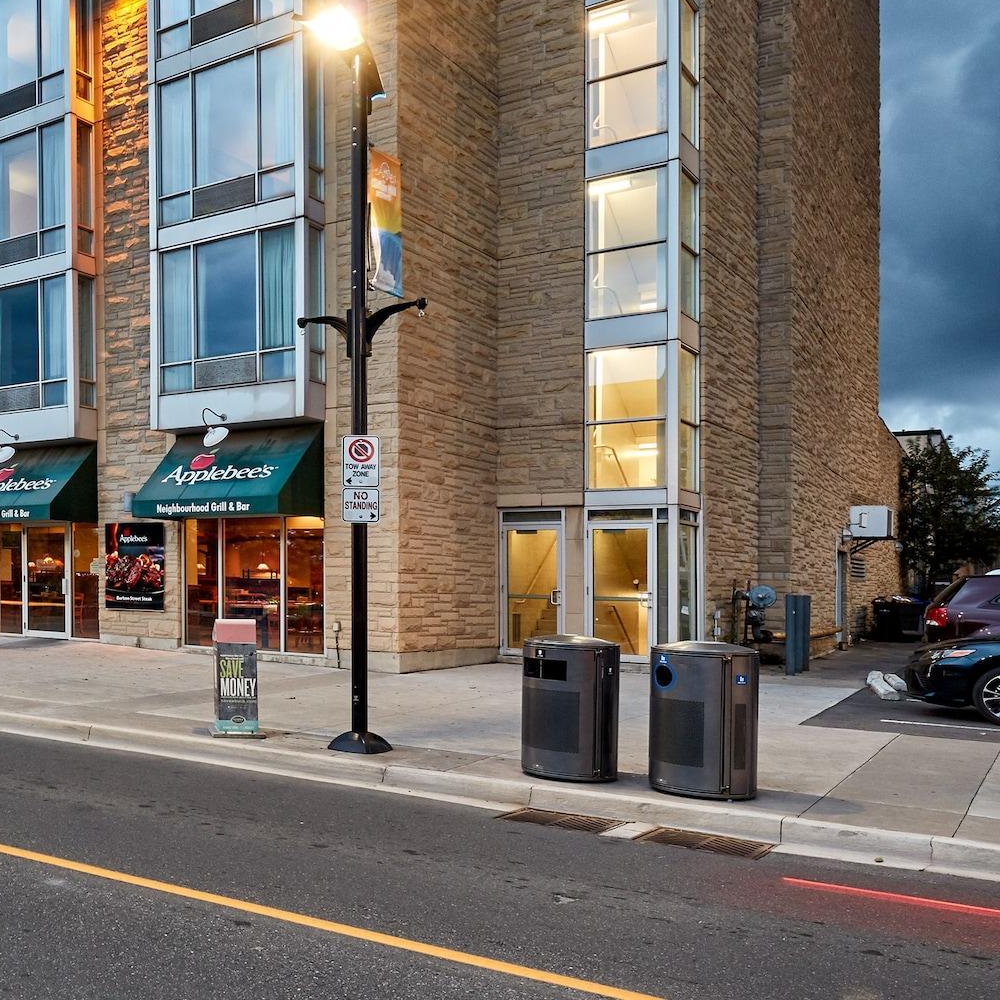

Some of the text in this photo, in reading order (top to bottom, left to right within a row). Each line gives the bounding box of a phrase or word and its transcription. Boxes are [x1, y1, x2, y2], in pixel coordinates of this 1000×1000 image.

[161, 464, 275, 485] Applebee's
[353, 491, 369, 500] NO
[156, 502, 250, 515] Neighbourhood Grill & Bar
[344, 501, 378, 510] STANDING
[20, 509, 30, 518] Bar
[220, 659, 244, 678] SAVE
[220, 678, 257, 697] MONEY
